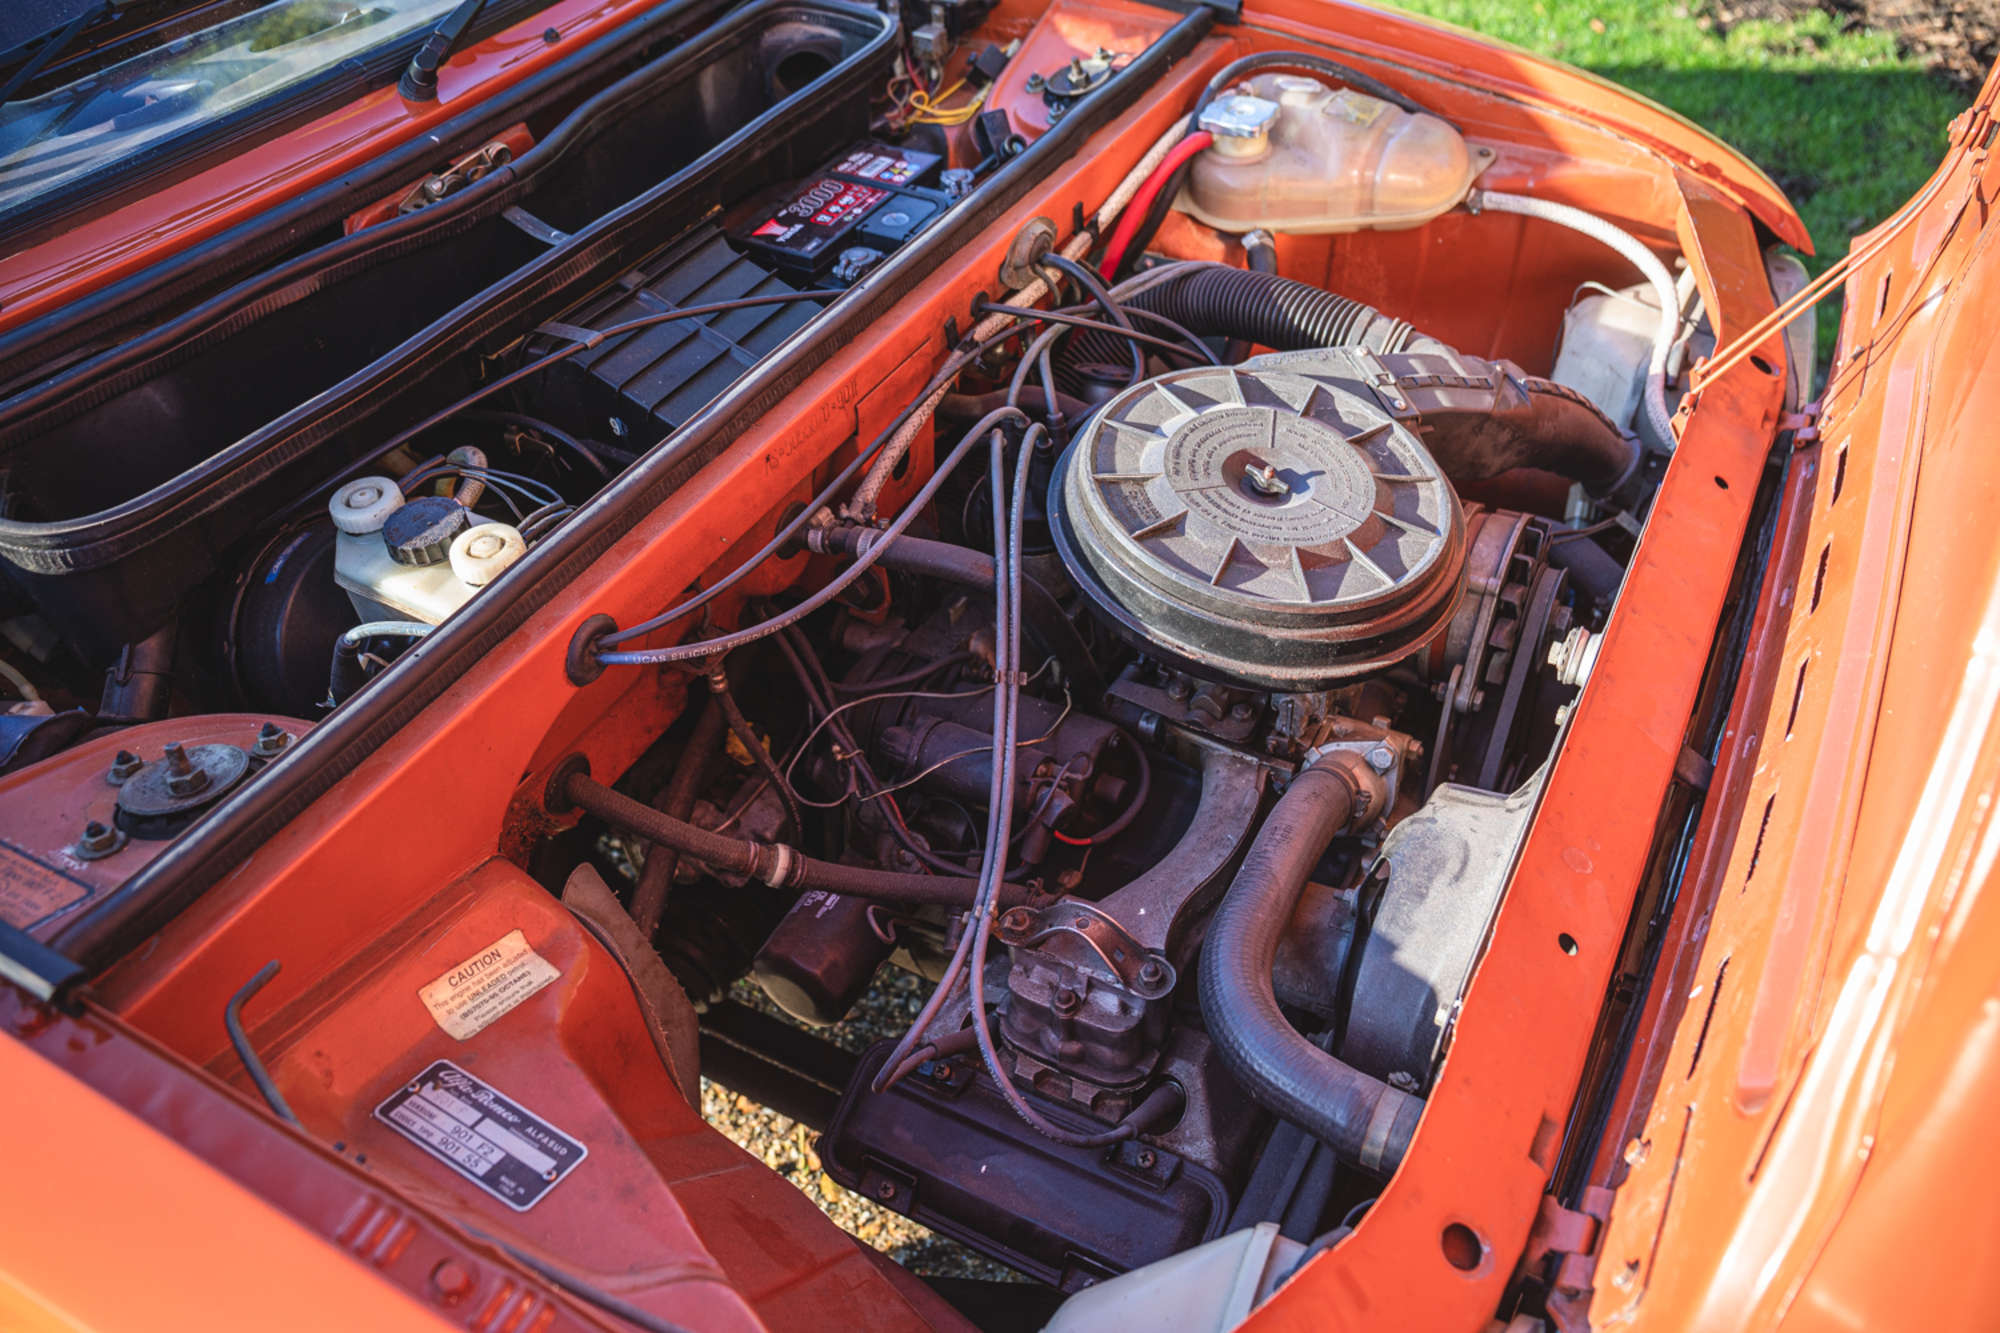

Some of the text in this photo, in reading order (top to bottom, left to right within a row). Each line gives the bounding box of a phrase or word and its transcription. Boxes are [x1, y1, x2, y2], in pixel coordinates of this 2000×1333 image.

[788, 180, 844, 216] 3000
[448, 949, 502, 987] CAUTION
[467, 974, 508, 1001] UNLEADED
[439, 1136, 459, 1155] 901
[450, 1125, 495, 1156] 901 F2
[525, 1126, 568, 1156] ALFASUD
